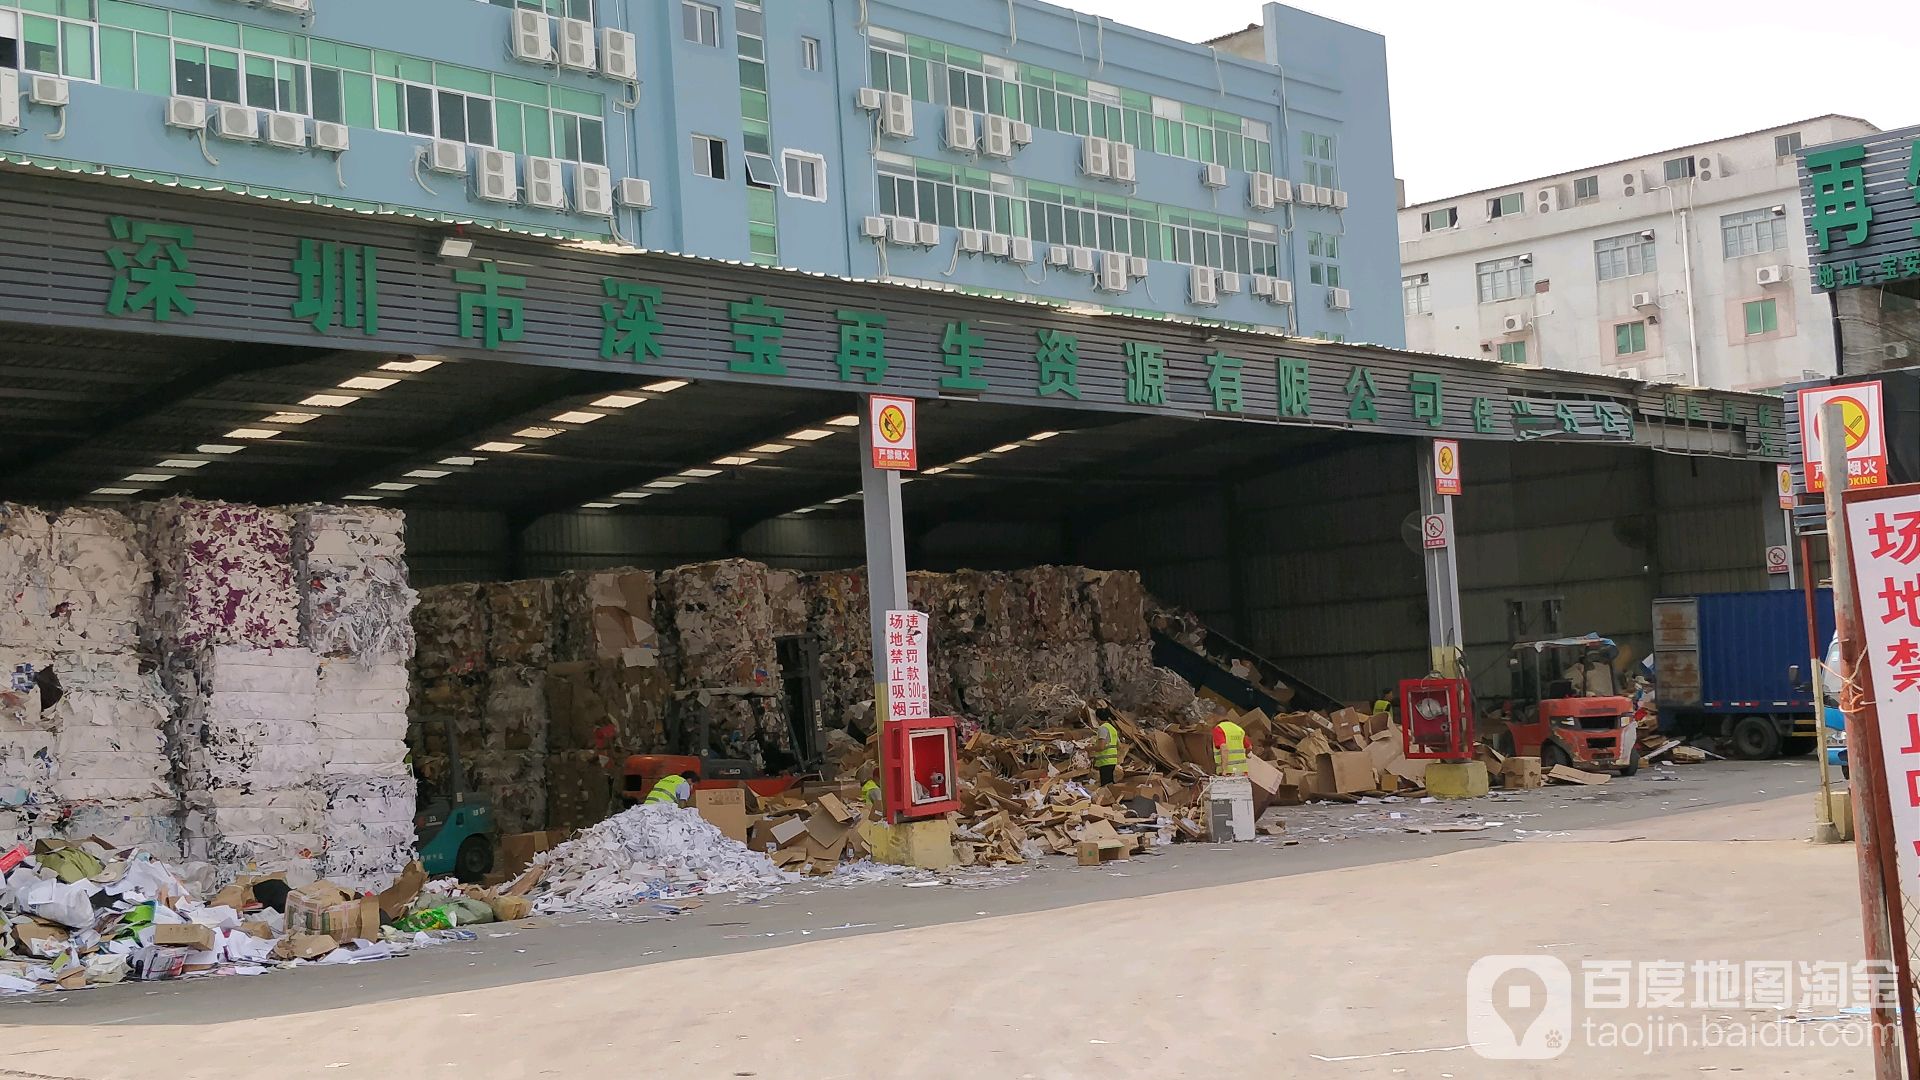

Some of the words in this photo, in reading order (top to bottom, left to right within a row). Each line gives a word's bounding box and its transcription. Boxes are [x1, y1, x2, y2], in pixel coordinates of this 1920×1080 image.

[107, 216, 1444, 427] 深圳市深宝再生资源有限公司
[1814, 459, 1878, 479] 严烟火
[889, 614, 906, 716] 场地禁止吸烟
